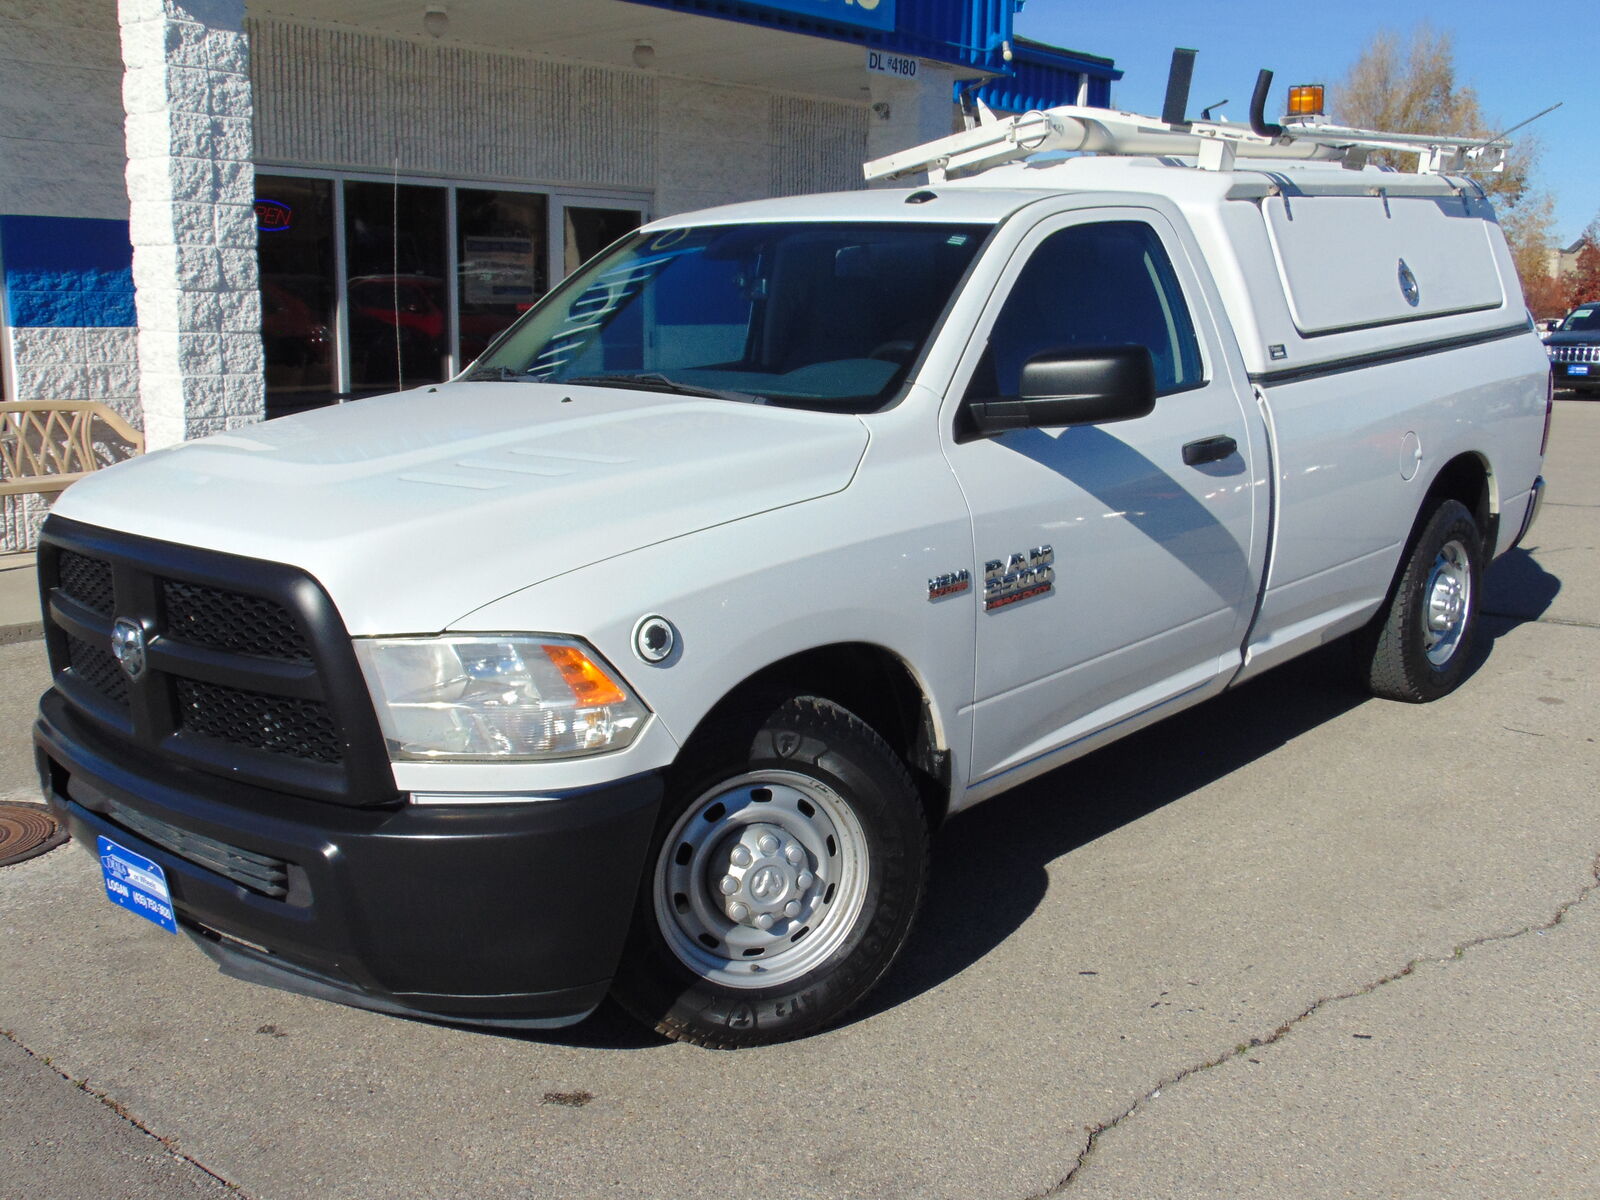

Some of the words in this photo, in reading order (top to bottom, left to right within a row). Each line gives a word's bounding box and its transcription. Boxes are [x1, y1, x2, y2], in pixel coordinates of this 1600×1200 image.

[869, 52, 885, 71] DL
[888, 57, 916, 76] #4180
[254, 205, 292, 225] PEN
[984, 544, 1054, 581] RAM
[928, 568, 969, 592] HEMI
[984, 563, 1054, 599] 2500
[106, 878, 129, 898] LOGAN
